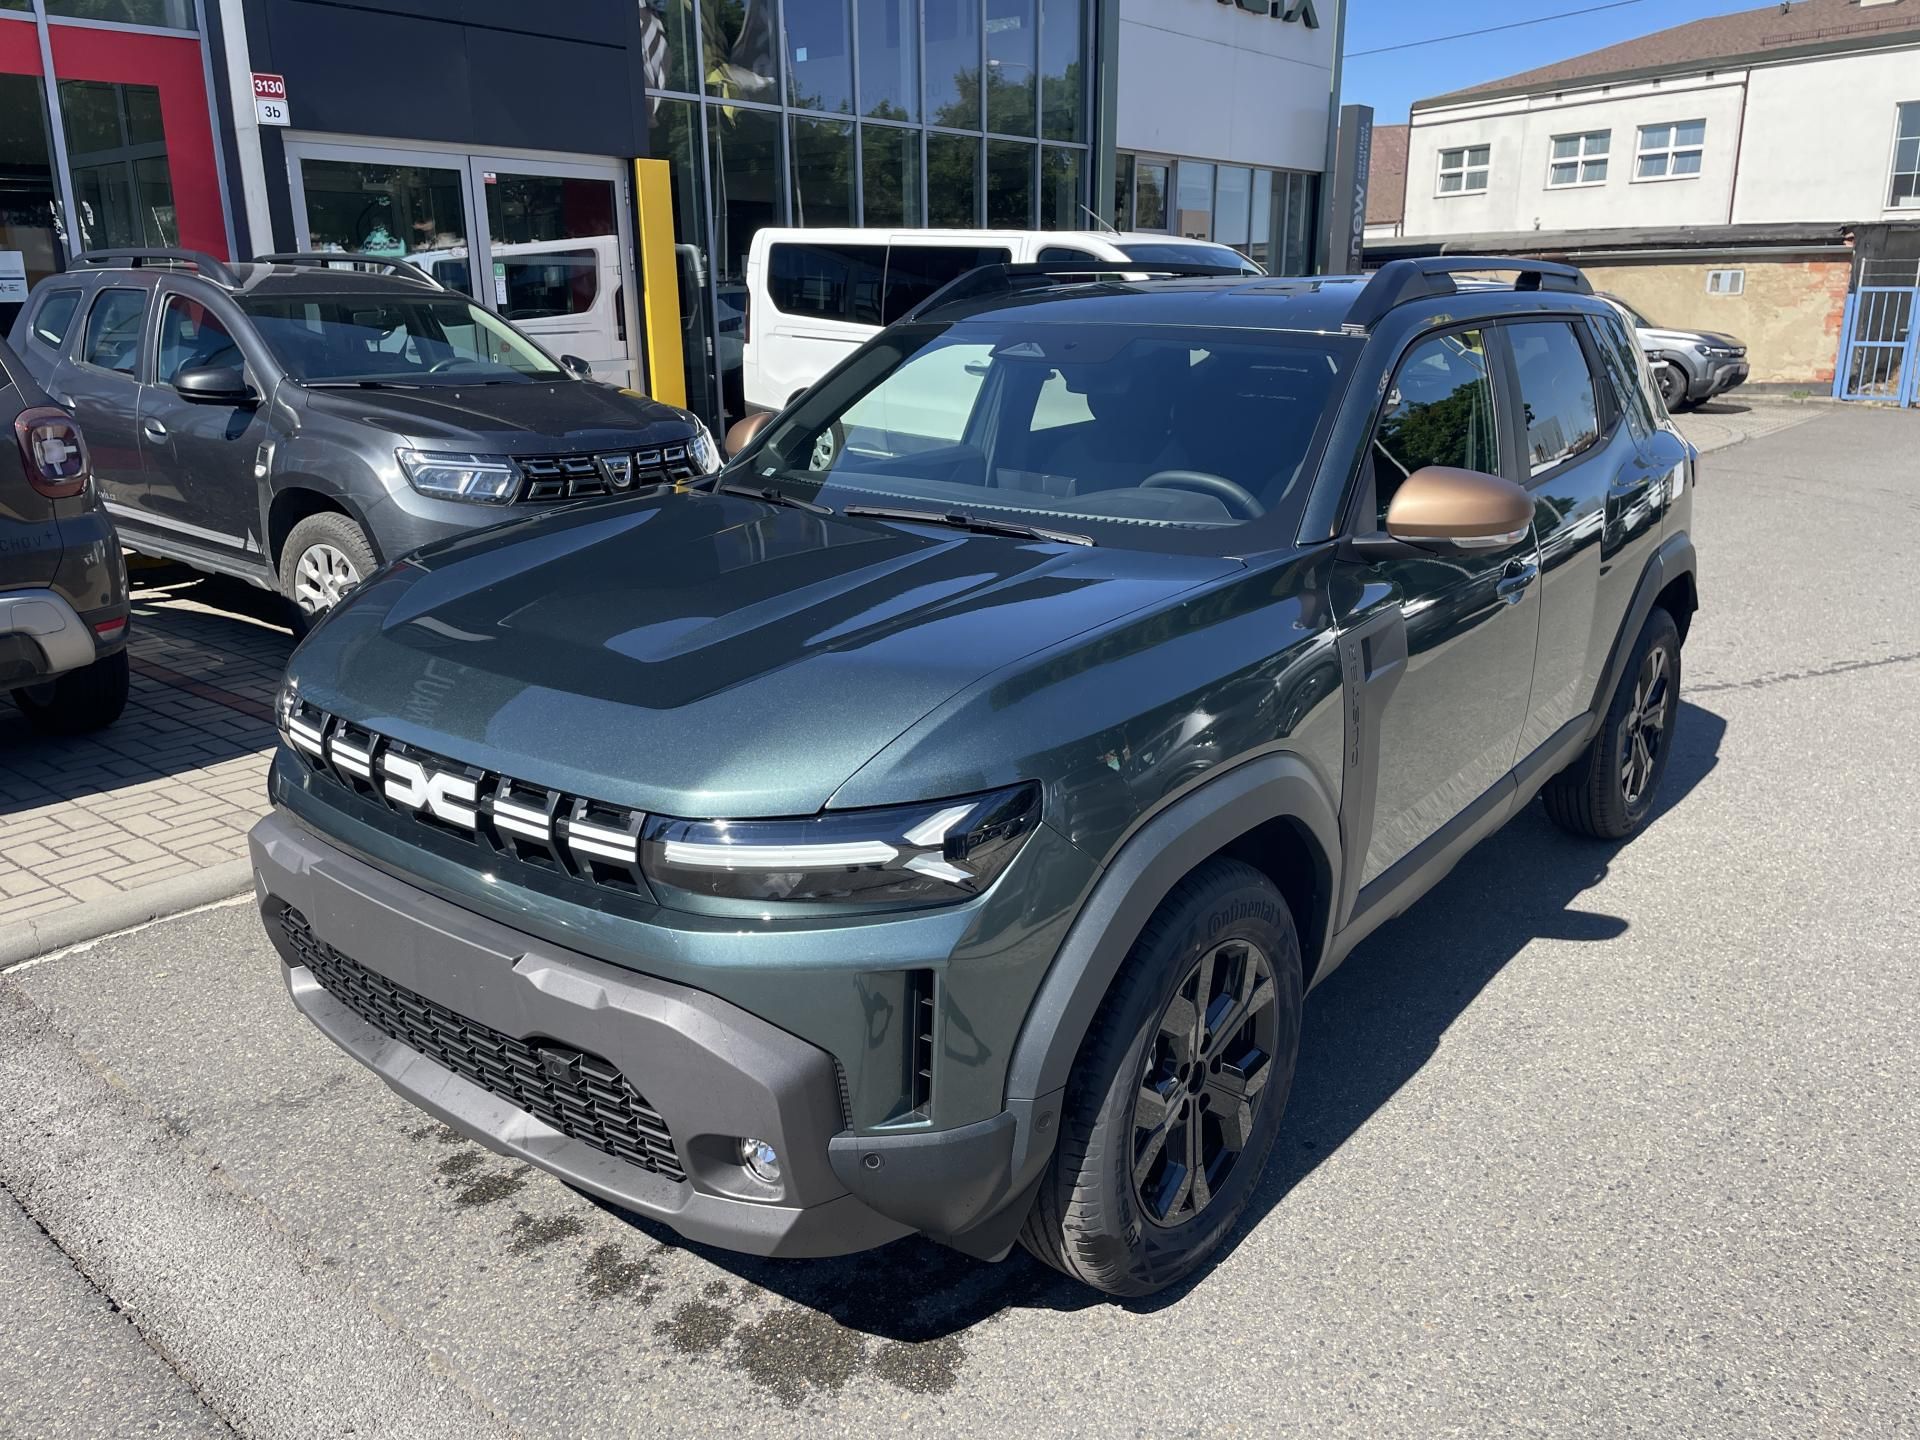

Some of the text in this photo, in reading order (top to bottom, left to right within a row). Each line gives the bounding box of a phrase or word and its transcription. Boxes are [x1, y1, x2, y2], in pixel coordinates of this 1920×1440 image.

[255, 80, 283, 94] 3130
[265, 105, 281, 118] 3b
[1348, 643, 1359, 768] DUSTER
[1208, 898, 1276, 938] Continental
